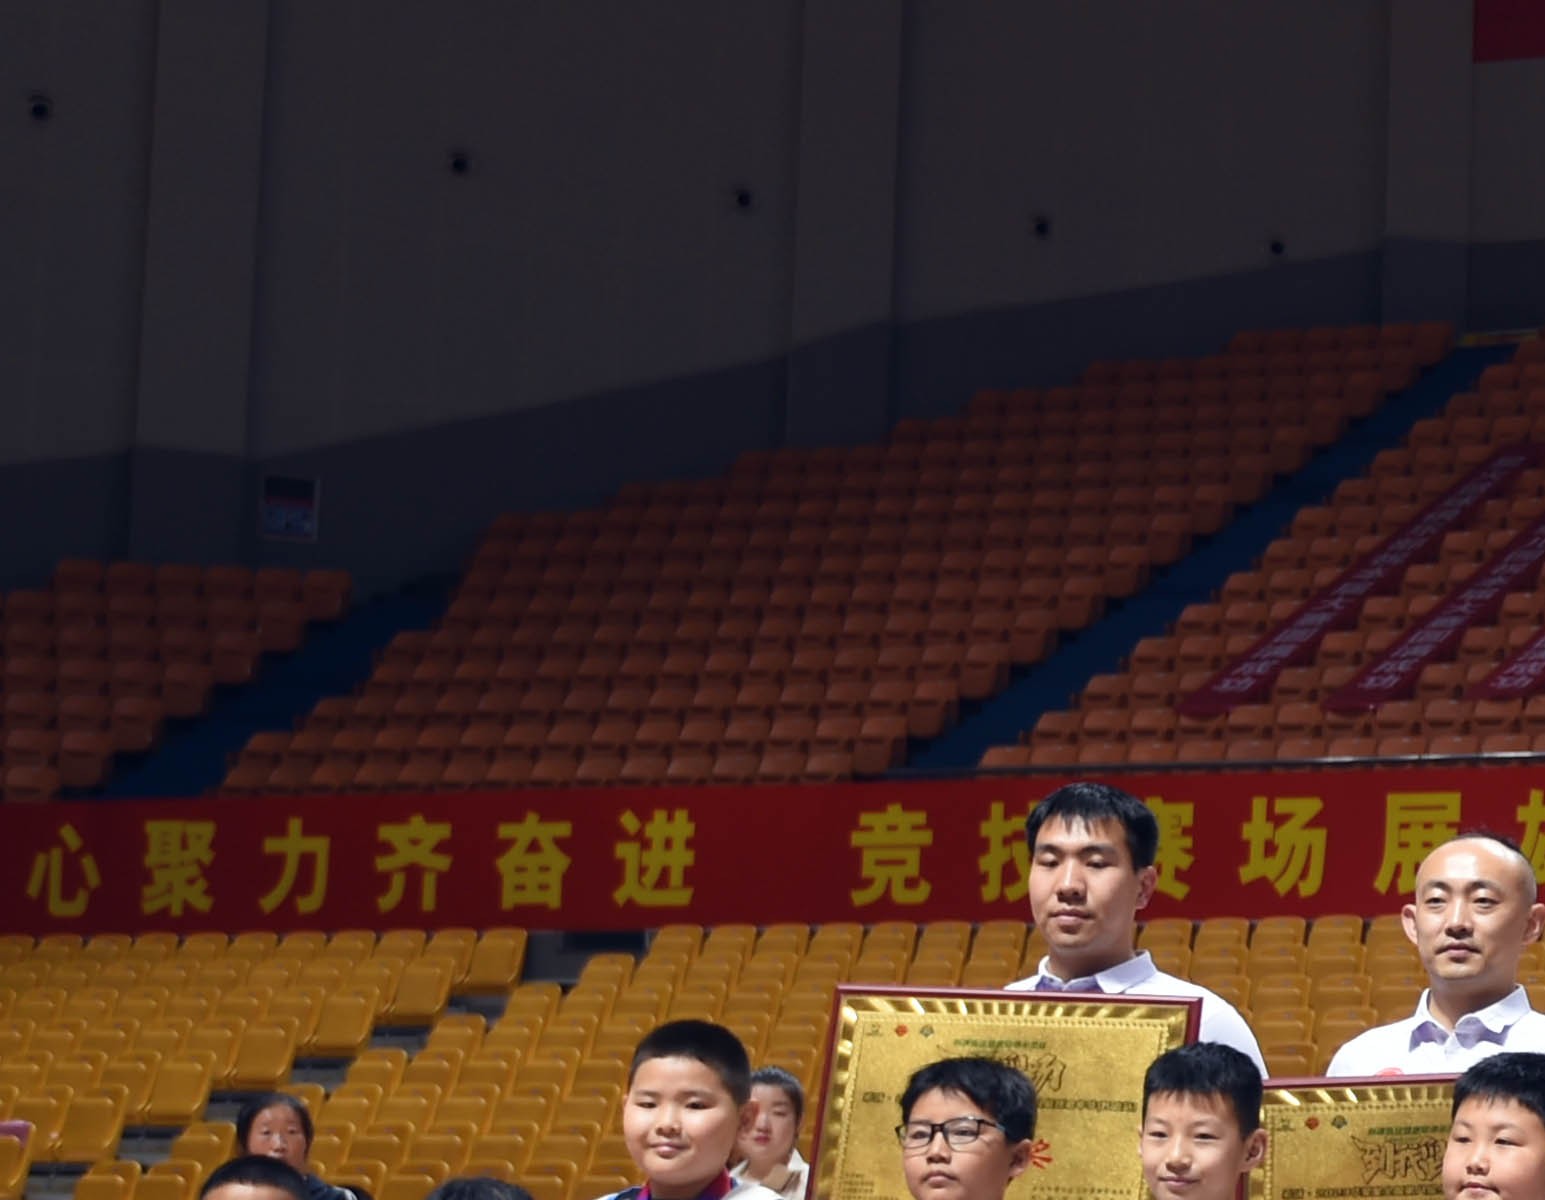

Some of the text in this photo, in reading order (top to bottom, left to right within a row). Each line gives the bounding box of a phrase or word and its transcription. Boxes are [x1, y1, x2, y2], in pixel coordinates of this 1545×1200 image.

[26, 807, 697, 918] 心聚力齐奋进
